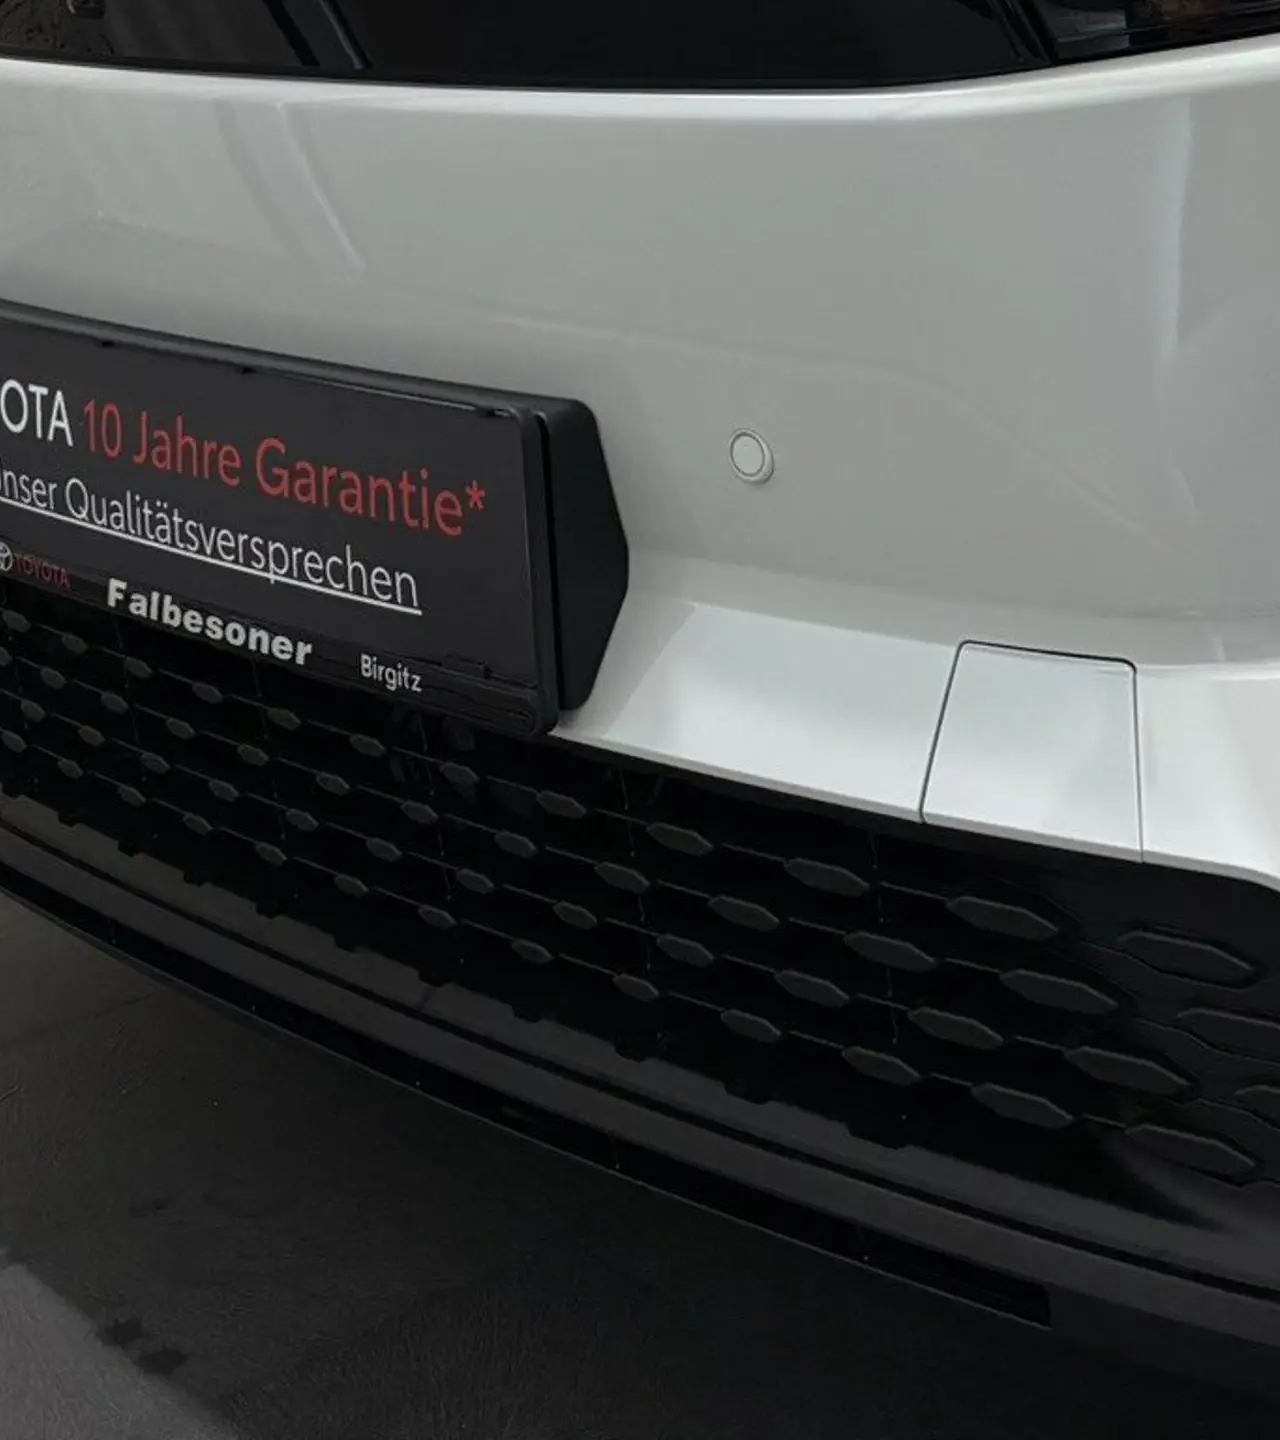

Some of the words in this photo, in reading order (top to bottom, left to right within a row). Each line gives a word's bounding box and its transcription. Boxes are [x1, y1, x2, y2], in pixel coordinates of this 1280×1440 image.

[83, 399, 122, 459] 10
[132, 410, 242, 487] Jahre
[64, 476, 420, 609] Qualitätsversprechen
[14, 551, 70, 589] TOYOTA
[106, 576, 314, 666] Falbesoner
[359, 652, 423, 693] Birgitz
